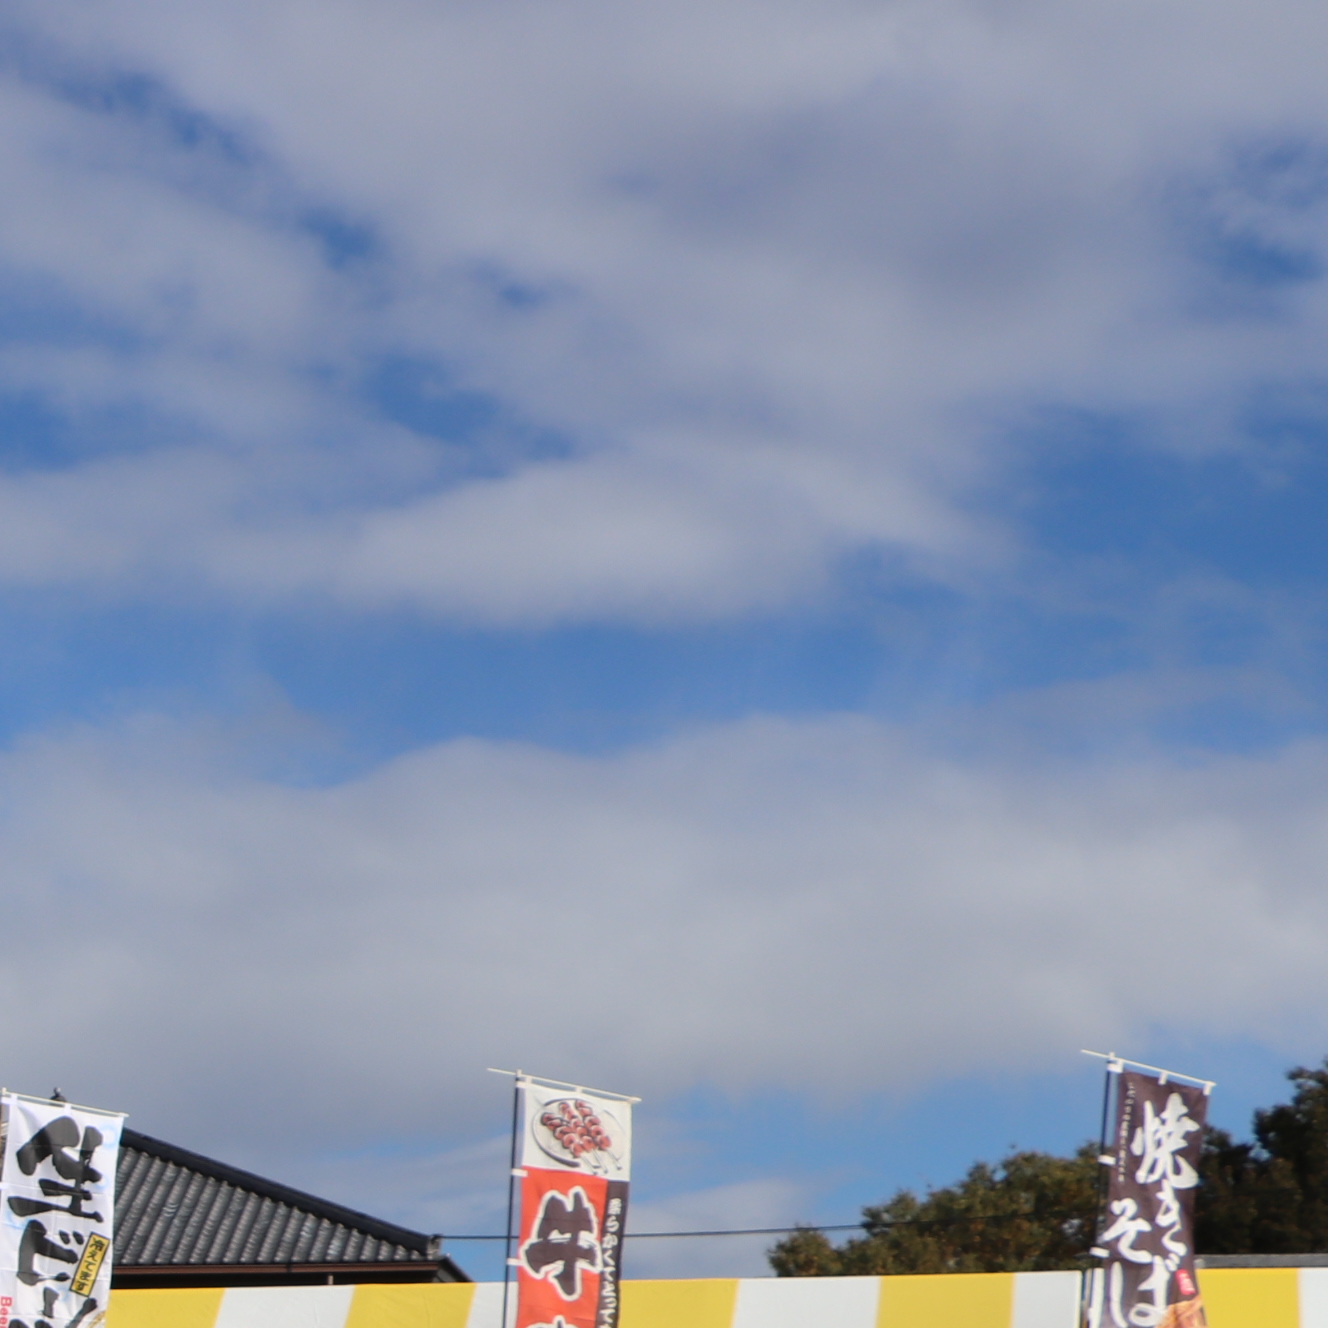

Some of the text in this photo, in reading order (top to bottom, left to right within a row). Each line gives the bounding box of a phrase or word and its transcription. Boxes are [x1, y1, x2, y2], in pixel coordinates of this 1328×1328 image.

[75, 1237, 105, 1291] 冷えてます
